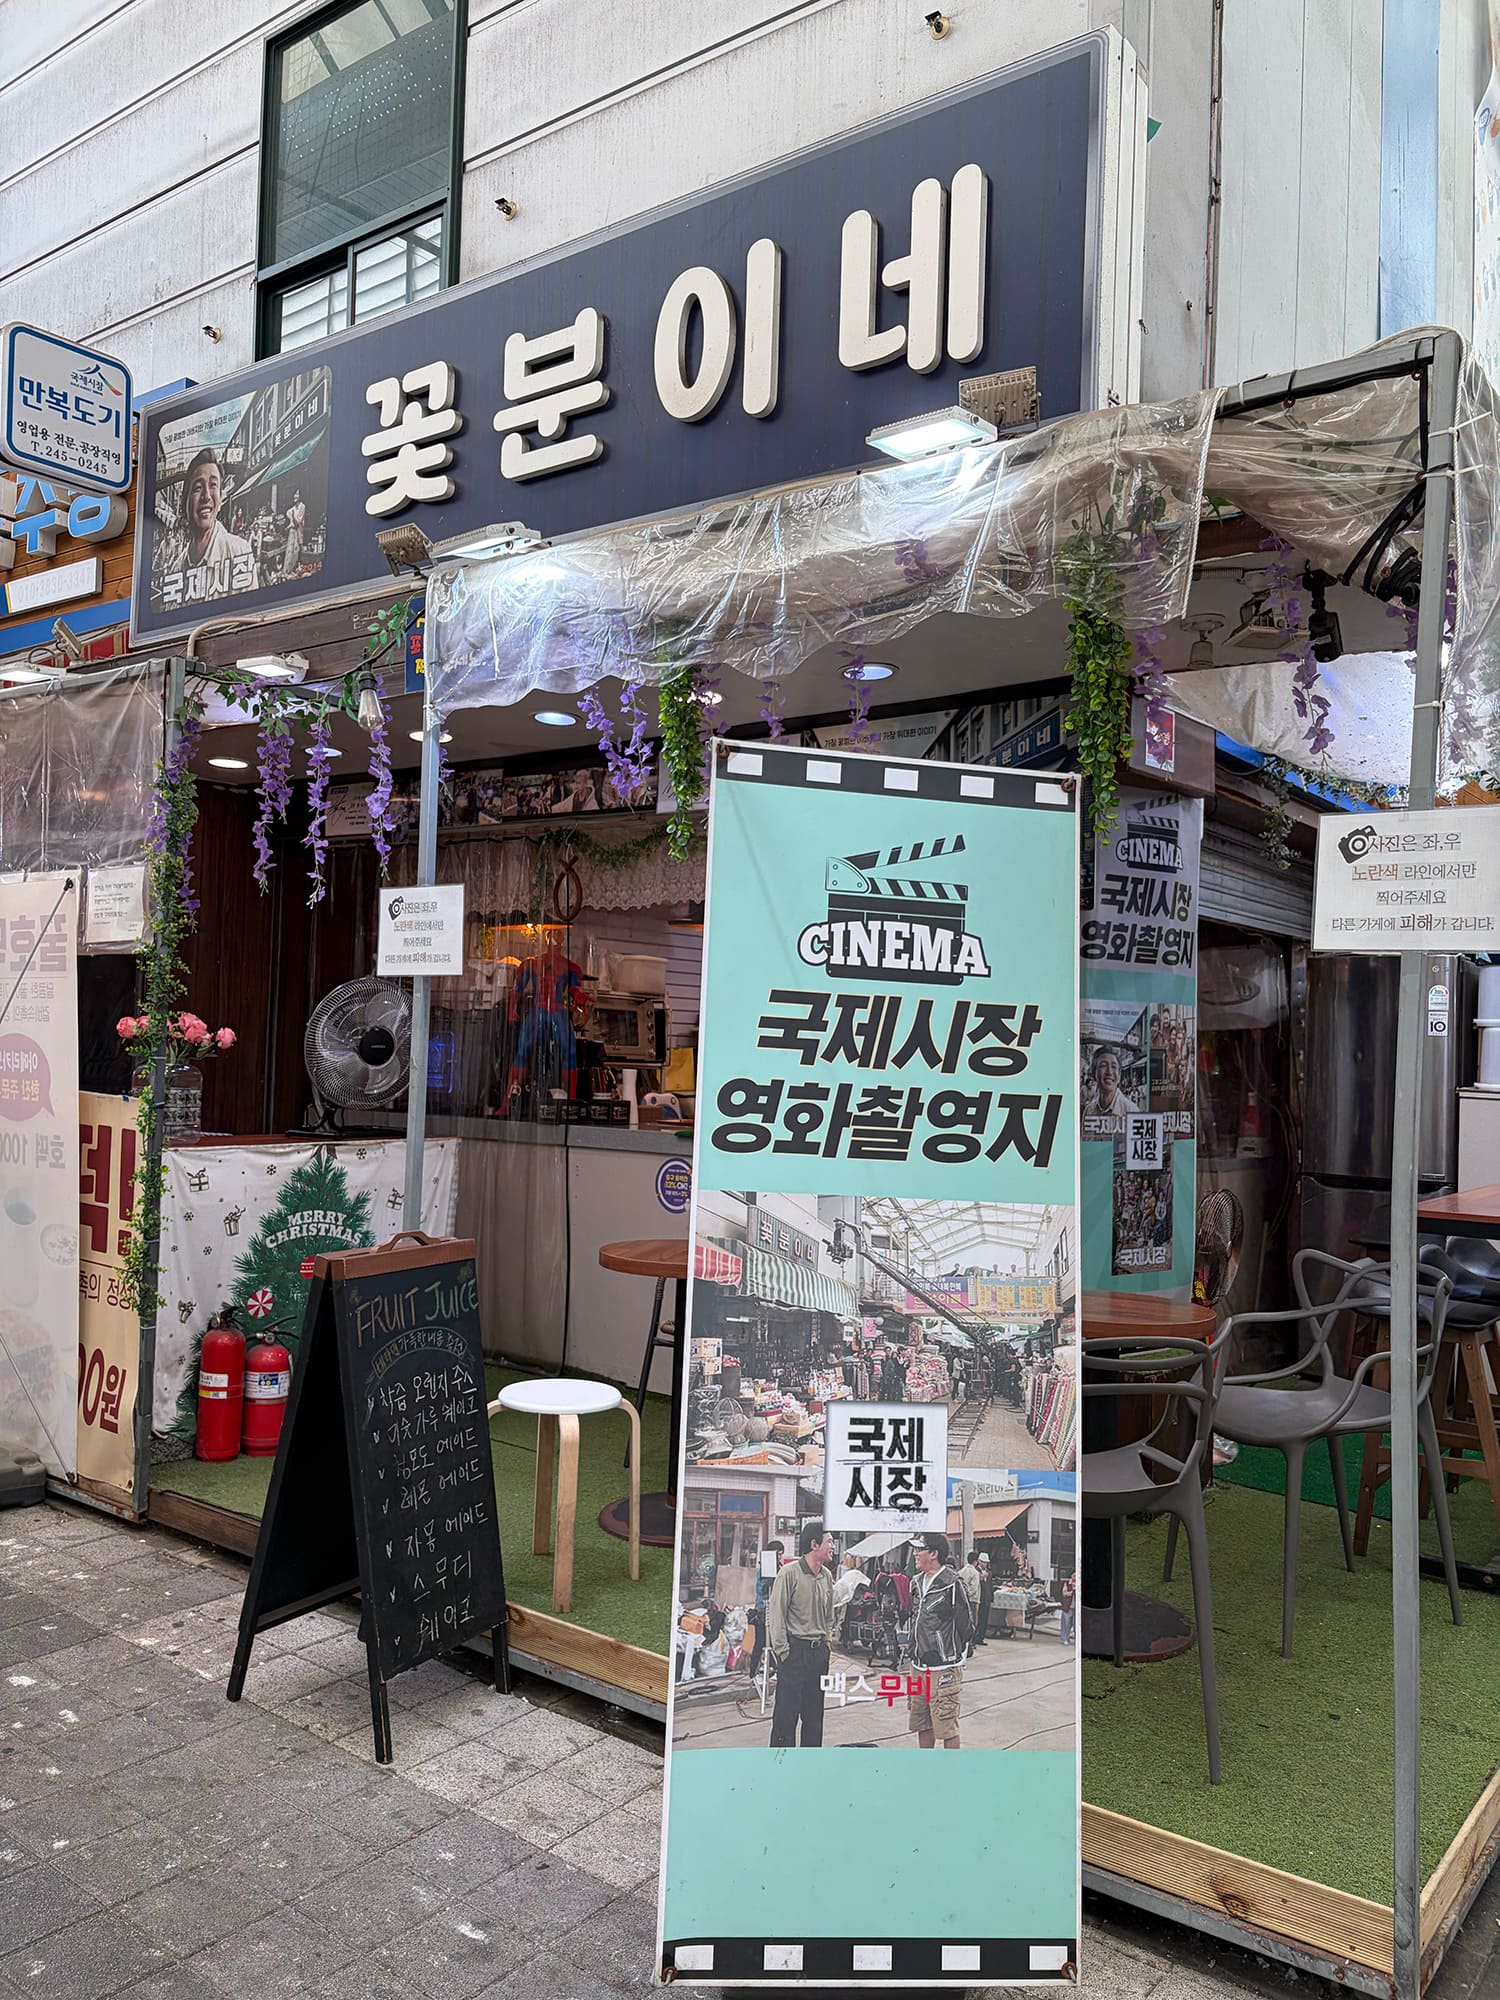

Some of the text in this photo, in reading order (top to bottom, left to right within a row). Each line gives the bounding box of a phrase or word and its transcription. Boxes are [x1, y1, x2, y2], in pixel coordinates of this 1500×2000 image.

[362, 162, 990, 518] 꽃분이네
[71, 371, 104, 391] 국제시장
[19, 376, 121, 439] 만복도기
[17, 420, 50, 441] 영업용
[31, 440, 108, 475] T.245-0245
[163, 552, 256, 603] 국제시장
[1116, 837, 1184, 869] CINEMA
[1369, 834, 1417, 853] 사진은
[1352, 863, 1477, 881] 노란색 라인에서만
[1101, 873, 1192, 922] 국제시장
[1376, 889, 1448, 906] 찍어주세요
[1331, 913, 1496, 932] 다른 가게에 피해가 갑니다.
[799, 920, 989, 976] CINEMA
[1080, 919, 1195, 969] 영화촬영지
[757, 989, 1044, 1077] 국제시장
[711, 1078, 1064, 1169] 영화촬영지
[1084, 1115, 1126, 1135] 국제시
[1132, 1119, 1157, 1140] 국제
[1132, 1140, 1158, 1161] 시장
[287, 1209, 347, 1227] MERRY
[265, 1222, 363, 1249] CHRISTMAS
[355, 1278, 479, 1348] FRUIT JUICE
[413, 1368, 448, 1403] 오렌지
[451, 1365, 478, 1394] 주스
[436, 1427, 479, 1454] 에이드
[847, 1416, 925, 1462] 국제
[439, 1458, 484, 1490] 에이드
[845, 1465, 928, 1512] 시장
[445, 1503, 489, 1533] 에이드
[414, 1550, 473, 1602] 스무디
[820, 1668, 933, 1708] 맥스무비
